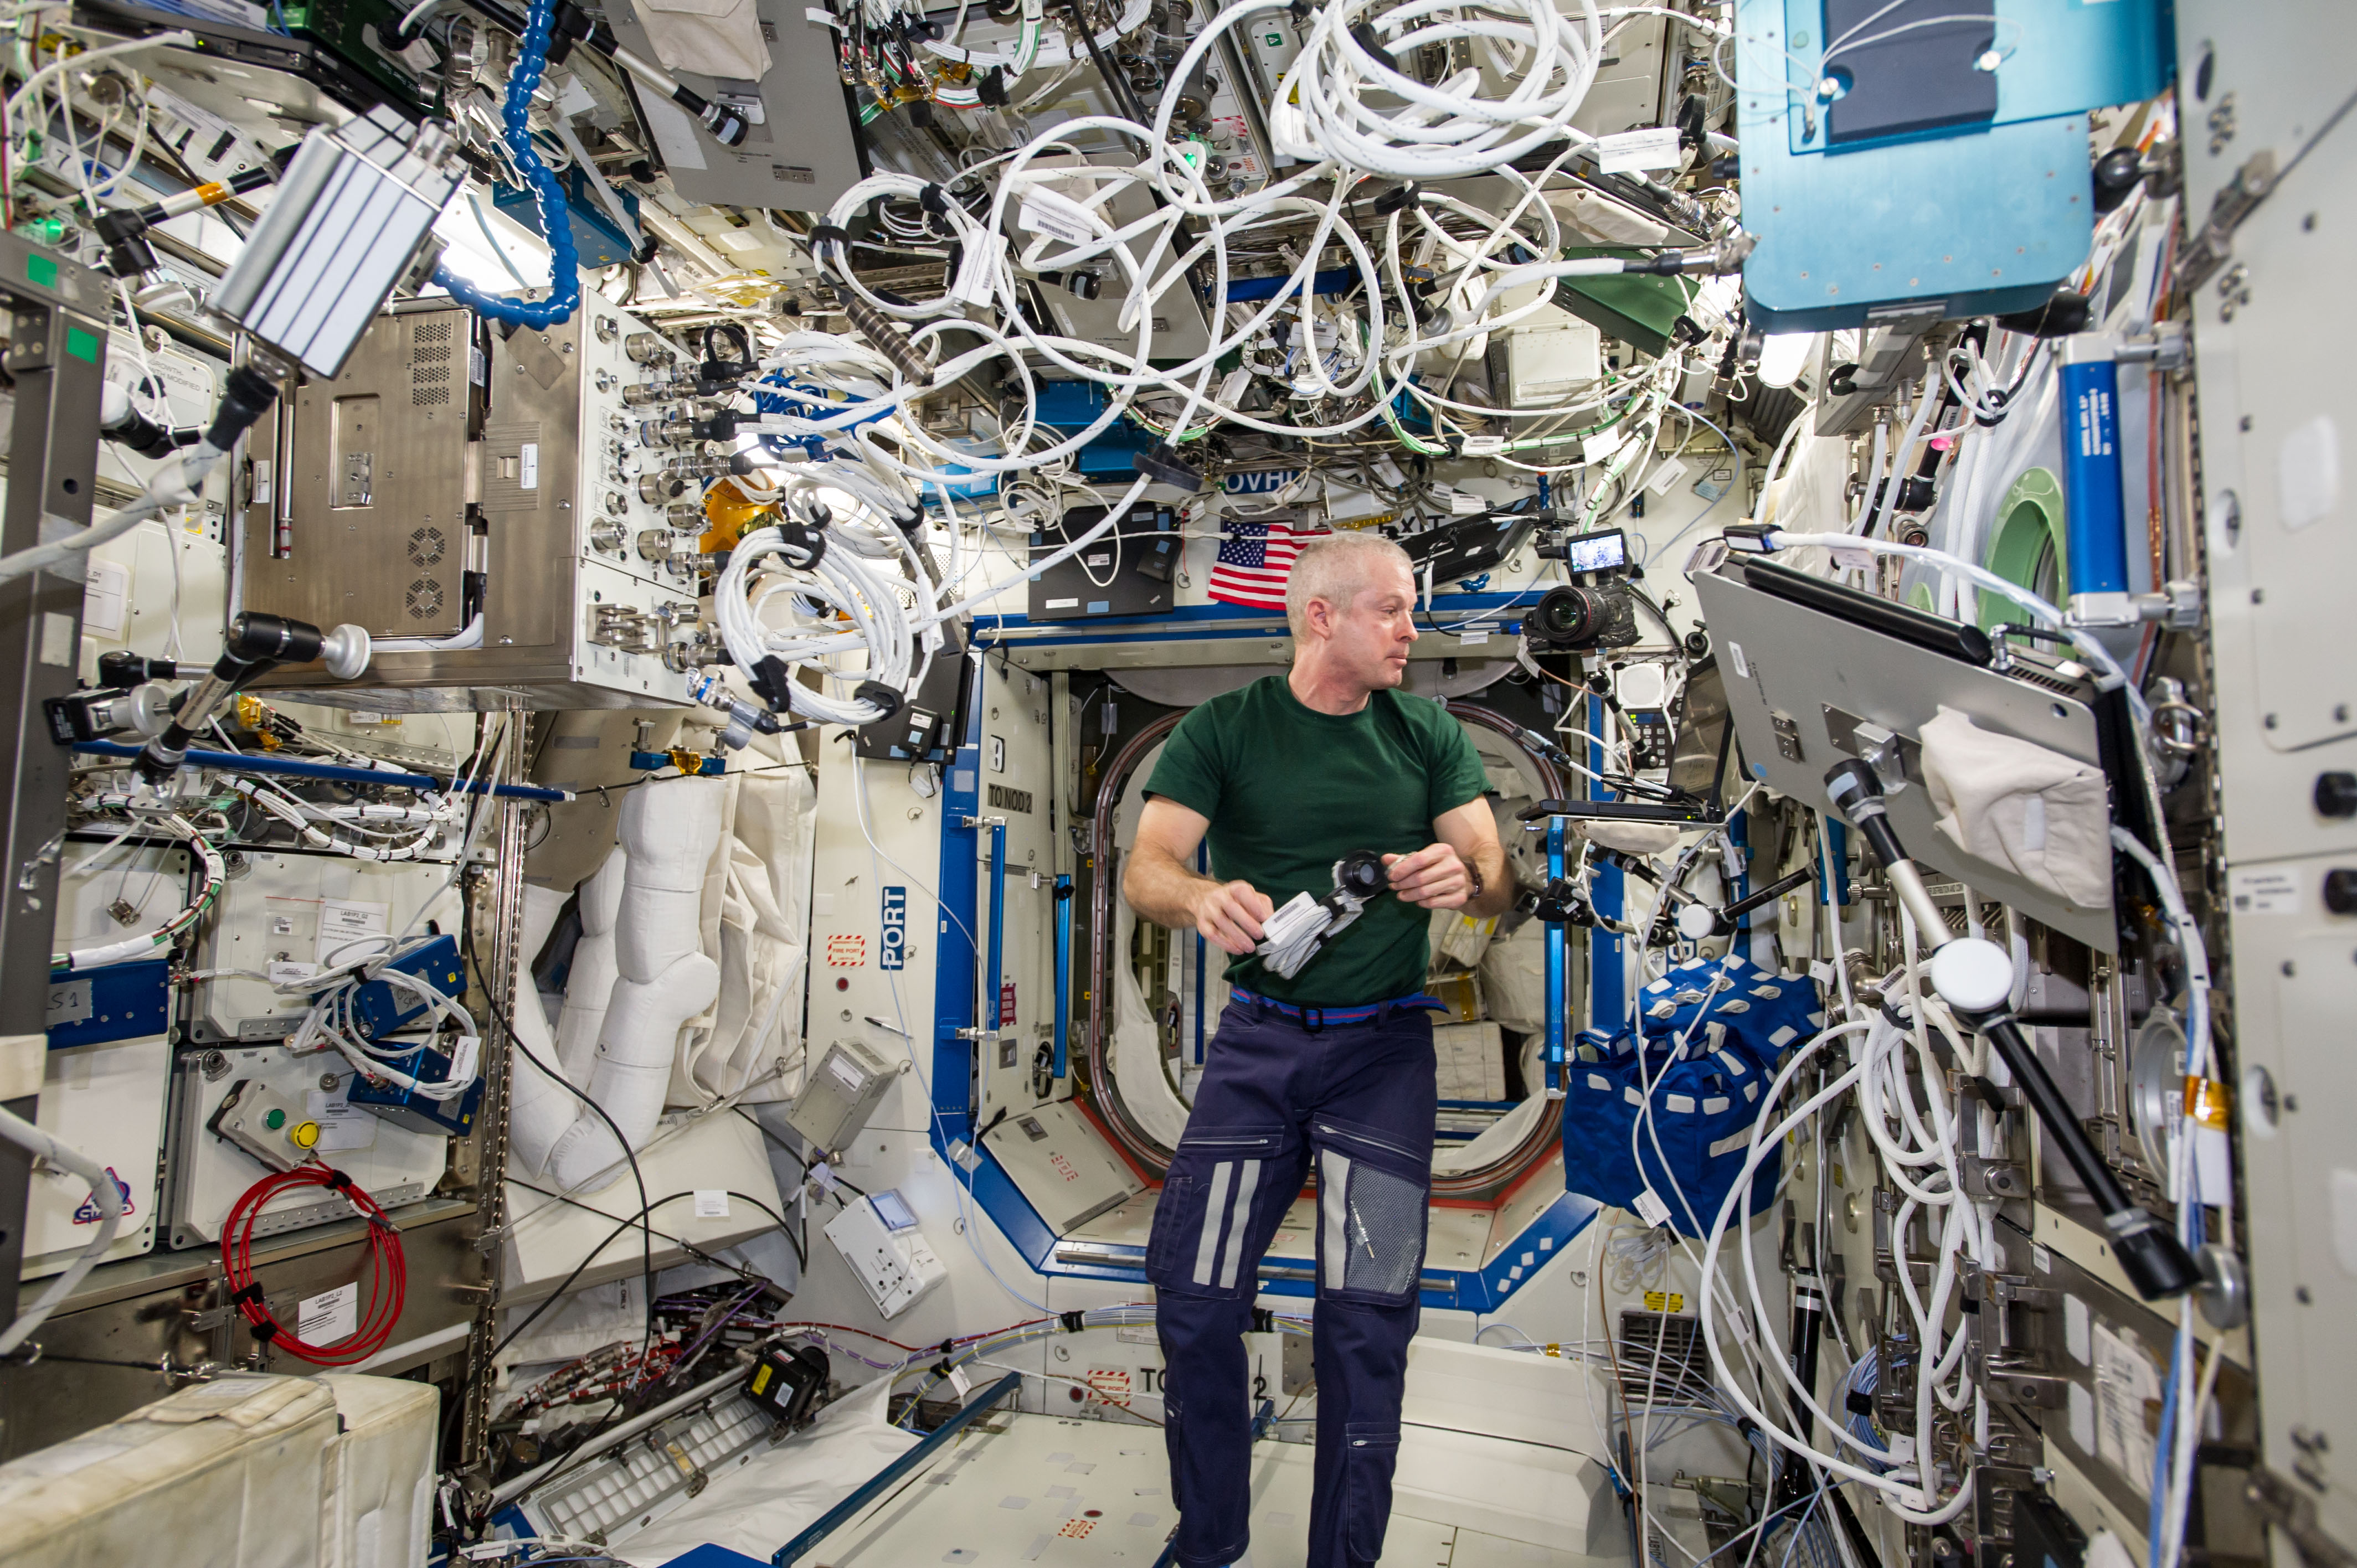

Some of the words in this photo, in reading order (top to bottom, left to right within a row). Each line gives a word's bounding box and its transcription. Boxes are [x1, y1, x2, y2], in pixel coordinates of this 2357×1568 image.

[167, 376, 200, 391] MODIFIED
[989, 784, 1001, 807] TO
[1004, 787, 1025, 811] NOD
[1026, 793, 1032, 813] 2
[882, 889, 904, 966] PORT
